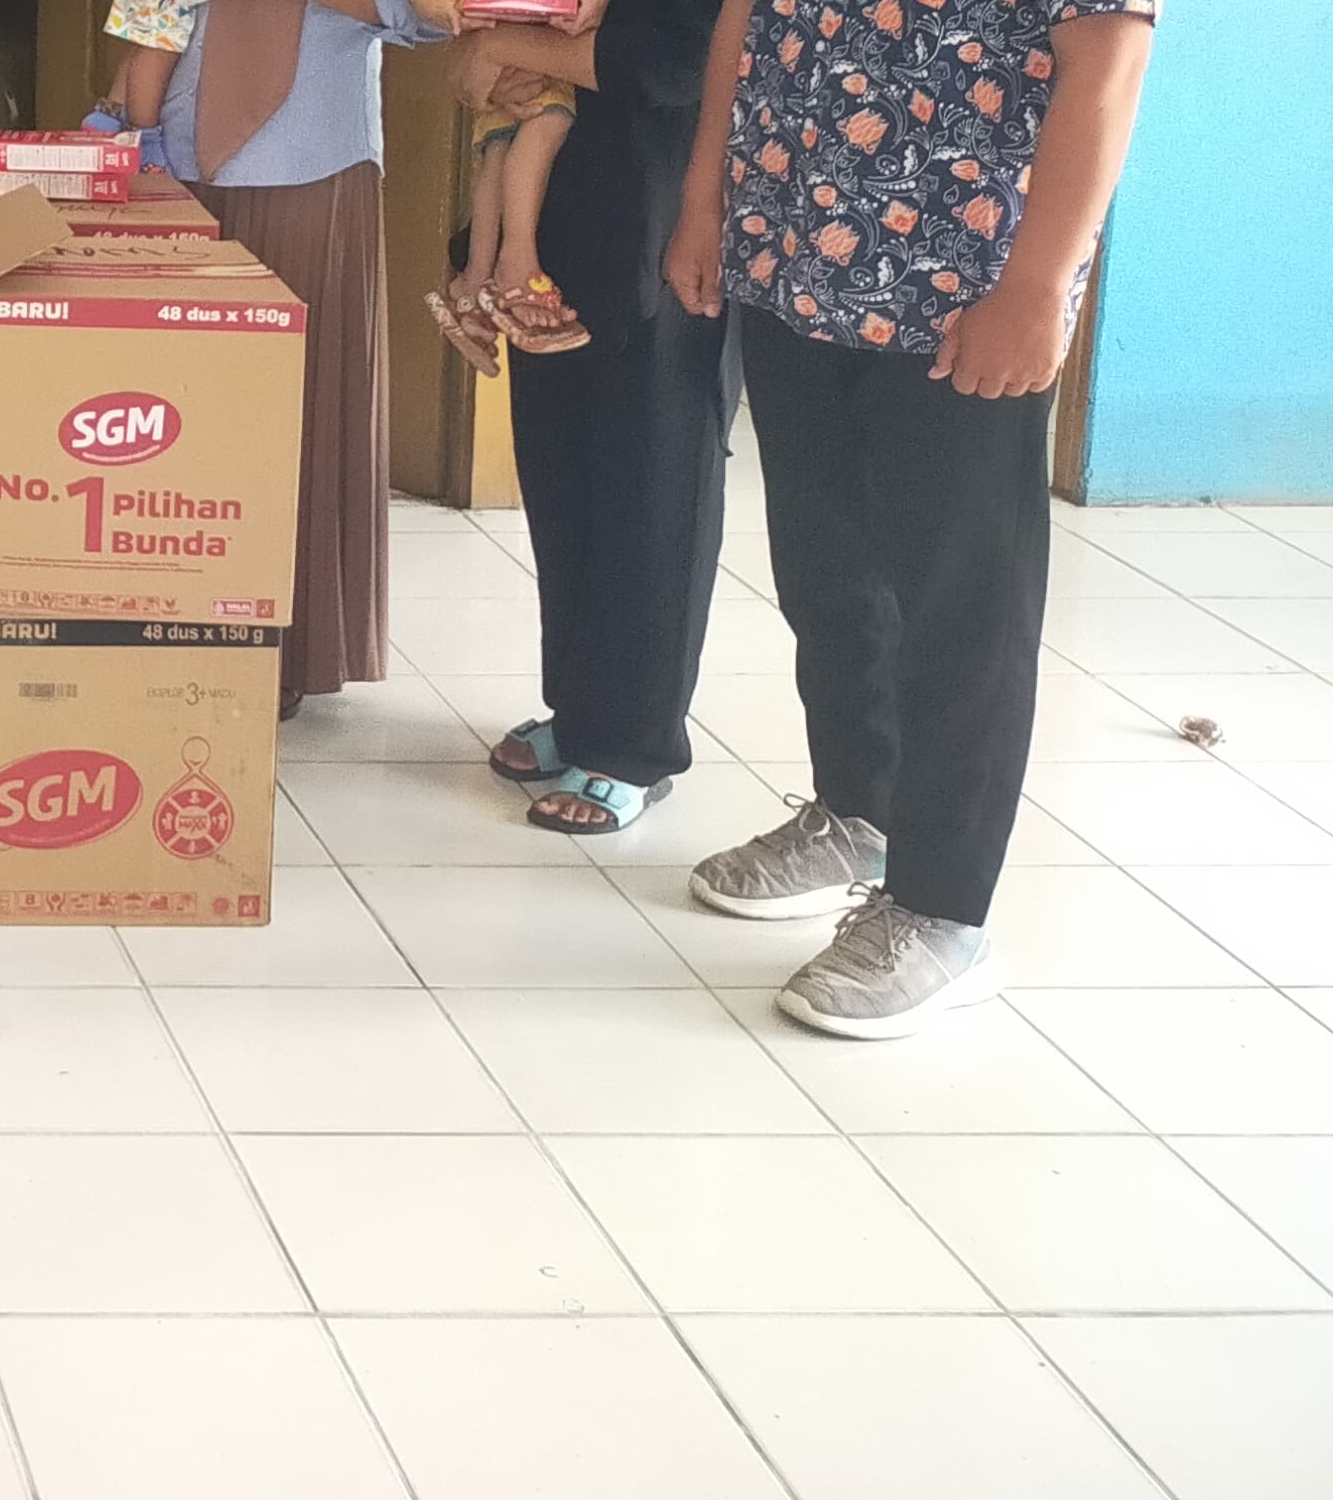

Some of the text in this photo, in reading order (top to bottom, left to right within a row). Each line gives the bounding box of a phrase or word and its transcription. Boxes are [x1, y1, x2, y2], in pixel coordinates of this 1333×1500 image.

[158, 306, 182, 321] 48
[186, 306, 221, 322] dus
[225, 310, 238, 323] x
[243, 308, 290, 327] 150g
[71, 404, 165, 449] SGM
[66, 476, 104, 553] 1
[112, 490, 242, 520] Pilihan
[142, 625, 162, 640] 48
[167, 625, 199, 641] dus
[203, 629, 213, 641] x
[219, 626, 248, 642] 150
[253, 630, 264, 645] g
